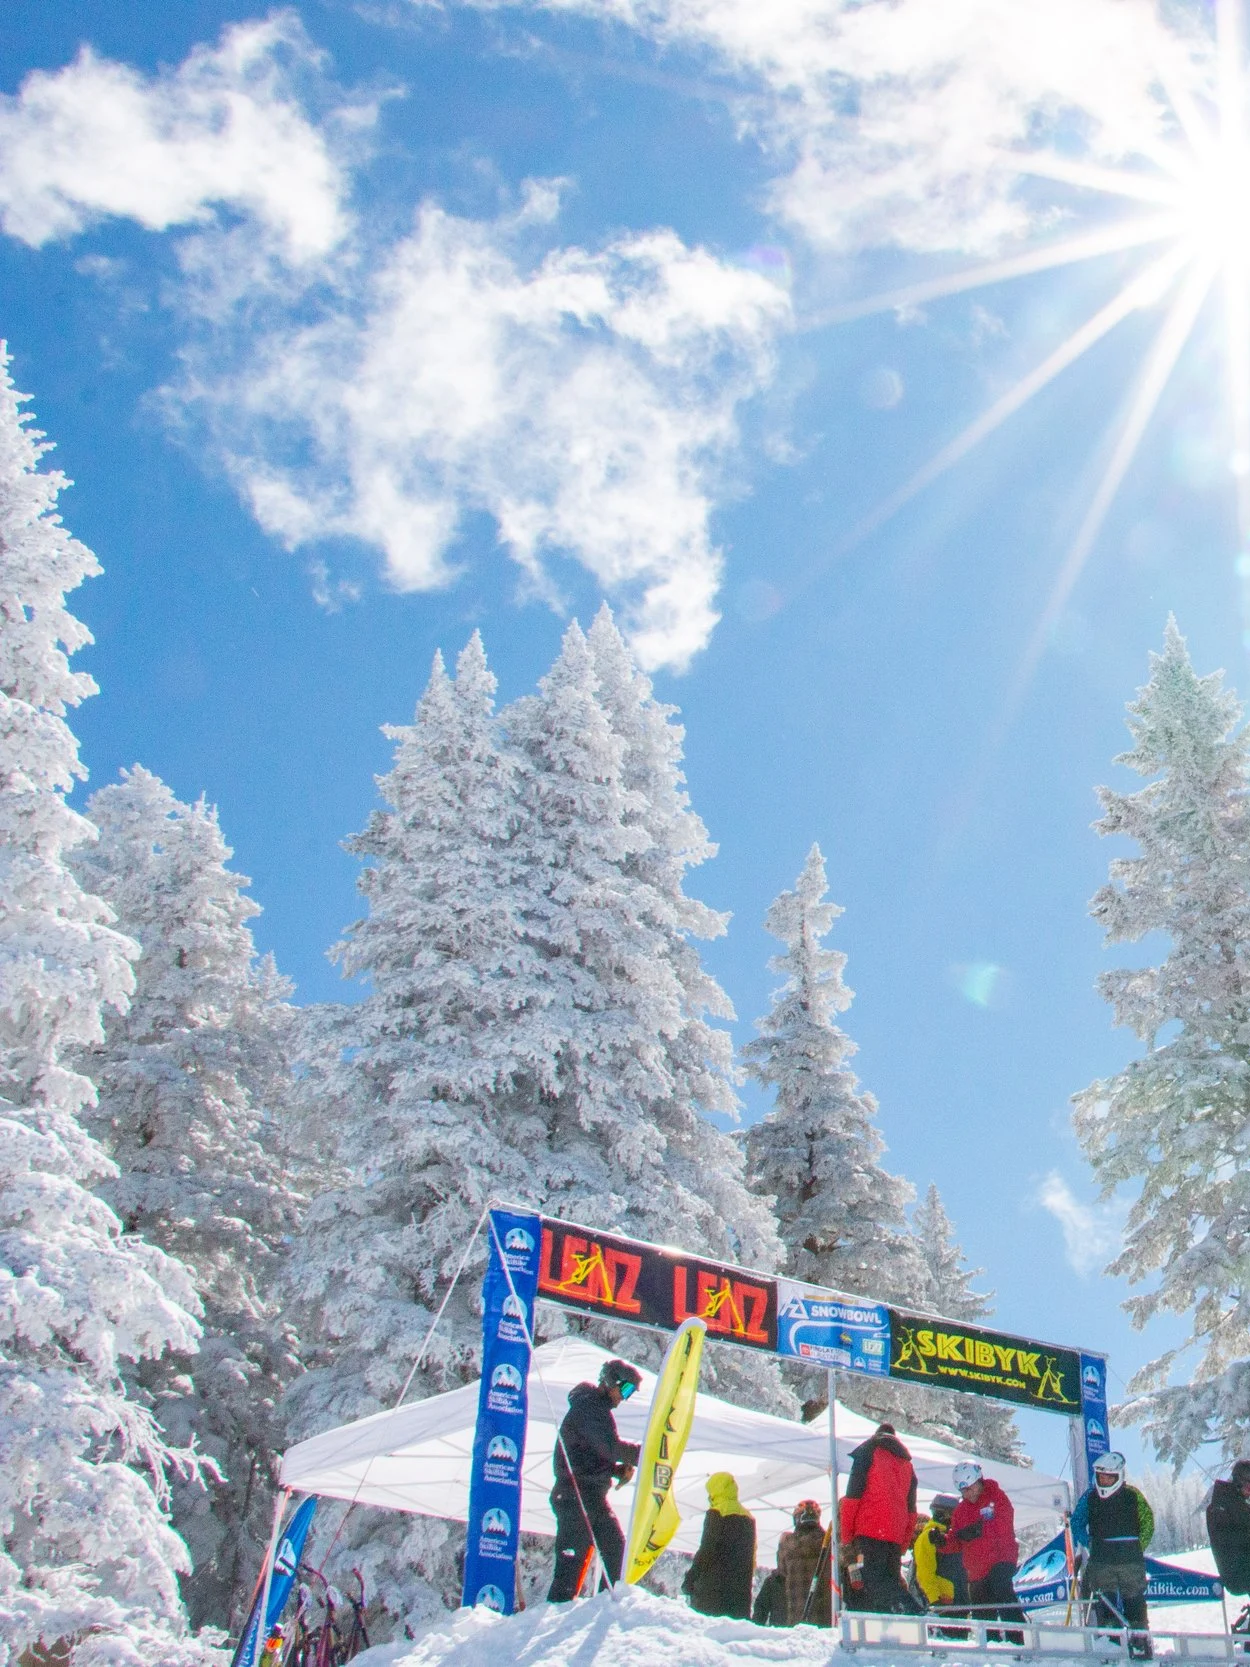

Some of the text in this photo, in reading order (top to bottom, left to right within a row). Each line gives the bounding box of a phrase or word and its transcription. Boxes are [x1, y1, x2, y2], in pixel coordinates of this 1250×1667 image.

[538, 1228, 768, 1343] LENZ LENZ
[811, 1305, 882, 1324] SNOWBOWL
[917, 1330, 1041, 1378] SKIBYK
[937, 1365, 1026, 1389] WWW.SKIBYK.COM
[1143, 1581, 1210, 1596] kiBike.com
